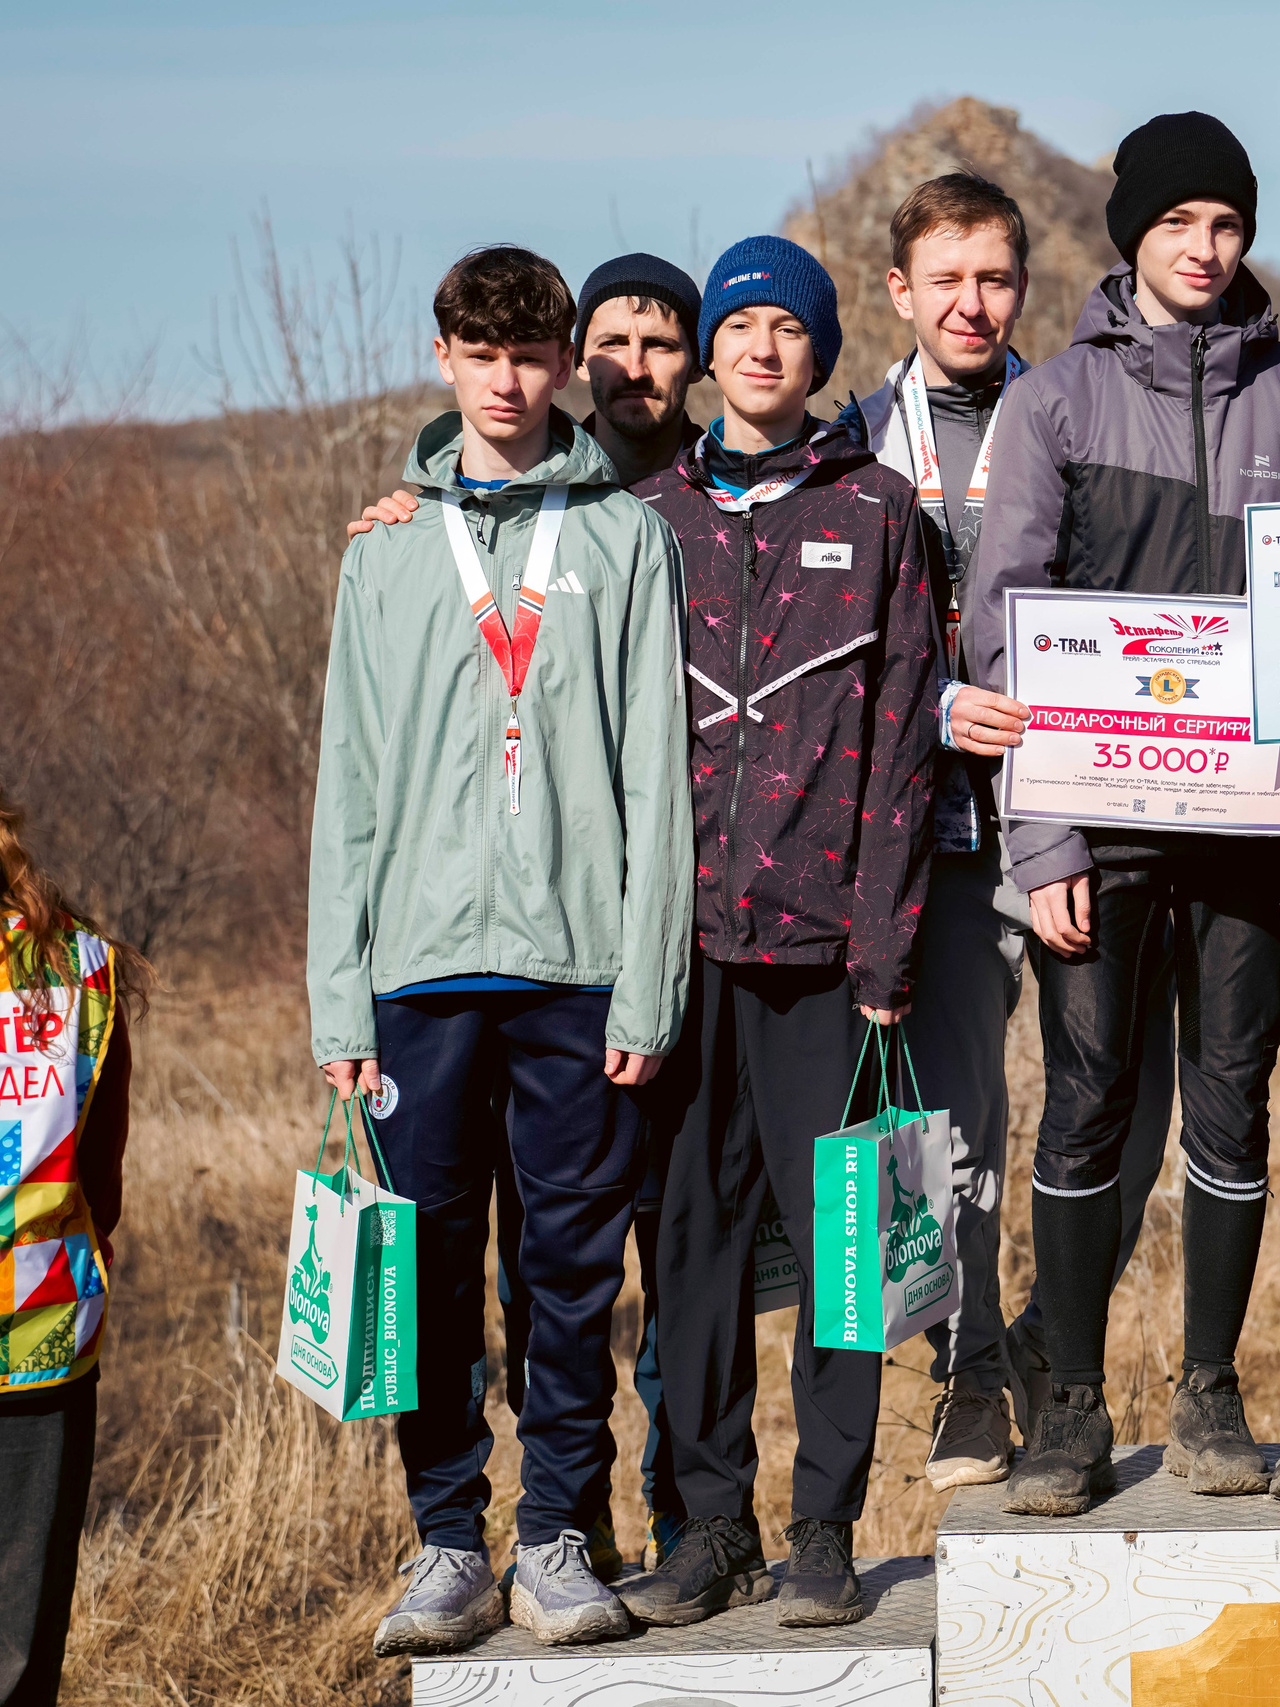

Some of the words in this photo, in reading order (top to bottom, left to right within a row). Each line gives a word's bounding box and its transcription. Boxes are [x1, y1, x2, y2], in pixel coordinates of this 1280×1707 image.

[729, 272, 751, 286] VOLUME
[752, 272, 762, 280] ON
[911, 387, 924, 431] ПОКОЛЕНИЙ
[919, 430, 933, 486] Эстафета
[821, 553, 842, 562] nike
[1108, 617, 1184, 638] Эстафета
[1149, 645, 1200, 655] ПОКОЛЕНИЙ
[1163, 679, 1174, 692] L
[1036, 710, 1165, 732] ПОДАРОЧНЫЙ
[1173, 719, 1251, 737] СЕРТИФИ
[1093, 742, 1132, 768] 35
[843, 1145, 858, 1343] BIONOVA-SHOP.RU
[885, 1226, 942, 1271] bionova
[289, 1277, 329, 1333] bionova
[907, 1286, 923, 1308] ДНЯ
[923, 1271, 950, 1297] ОСНОВА
[360, 1264, 375, 1411] ПОДПИШИСЬ
[384, 1265, 401, 1407] PUBLIC_BIONOVA
[293, 1342, 306, 1361] ДНЯ
[307, 1352, 332, 1380] ОСНОВА
